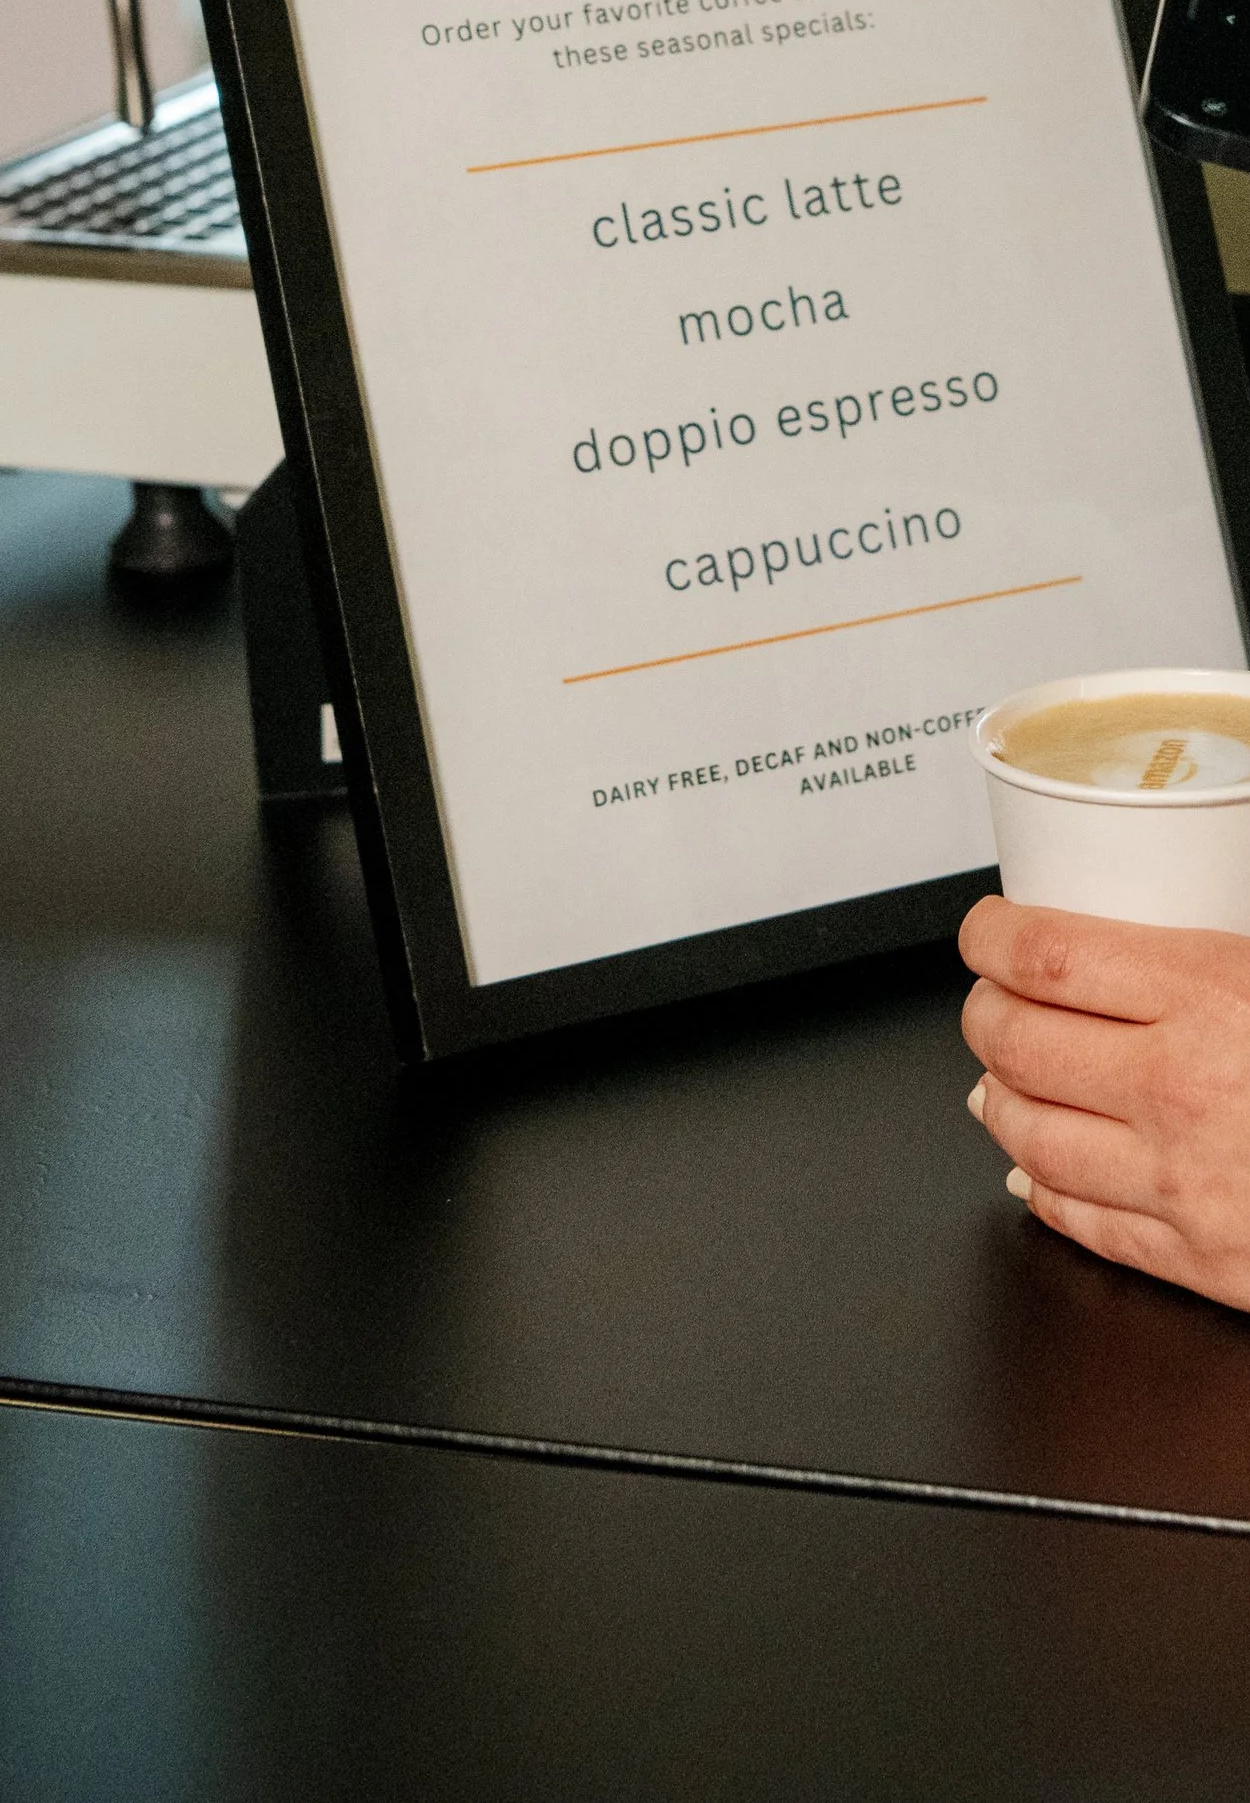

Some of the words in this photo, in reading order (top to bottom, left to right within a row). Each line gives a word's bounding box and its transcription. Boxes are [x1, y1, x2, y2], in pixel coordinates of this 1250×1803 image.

[421, 19, 501, 46] Order
[512, 10, 575, 42] your
[552, 44, 627, 69] these
[637, 23, 755, 59] seasonal
[761, 9, 876, 46] specials:
[592, 187, 768, 249] classic
[784, 173, 902, 220] latte
[678, 285, 850, 345] mocha
[573, 407, 756, 474] doppio
[777, 371, 999, 440] espresso
[665, 507, 961, 593] cappuccino
[592, 777, 659, 808] DAIRY
[667, 764, 729, 791] FREE,
[735, 744, 808, 777] DECAF
[814, 735, 859, 760] AND
[800, 753, 917, 795] AVAILABLE
